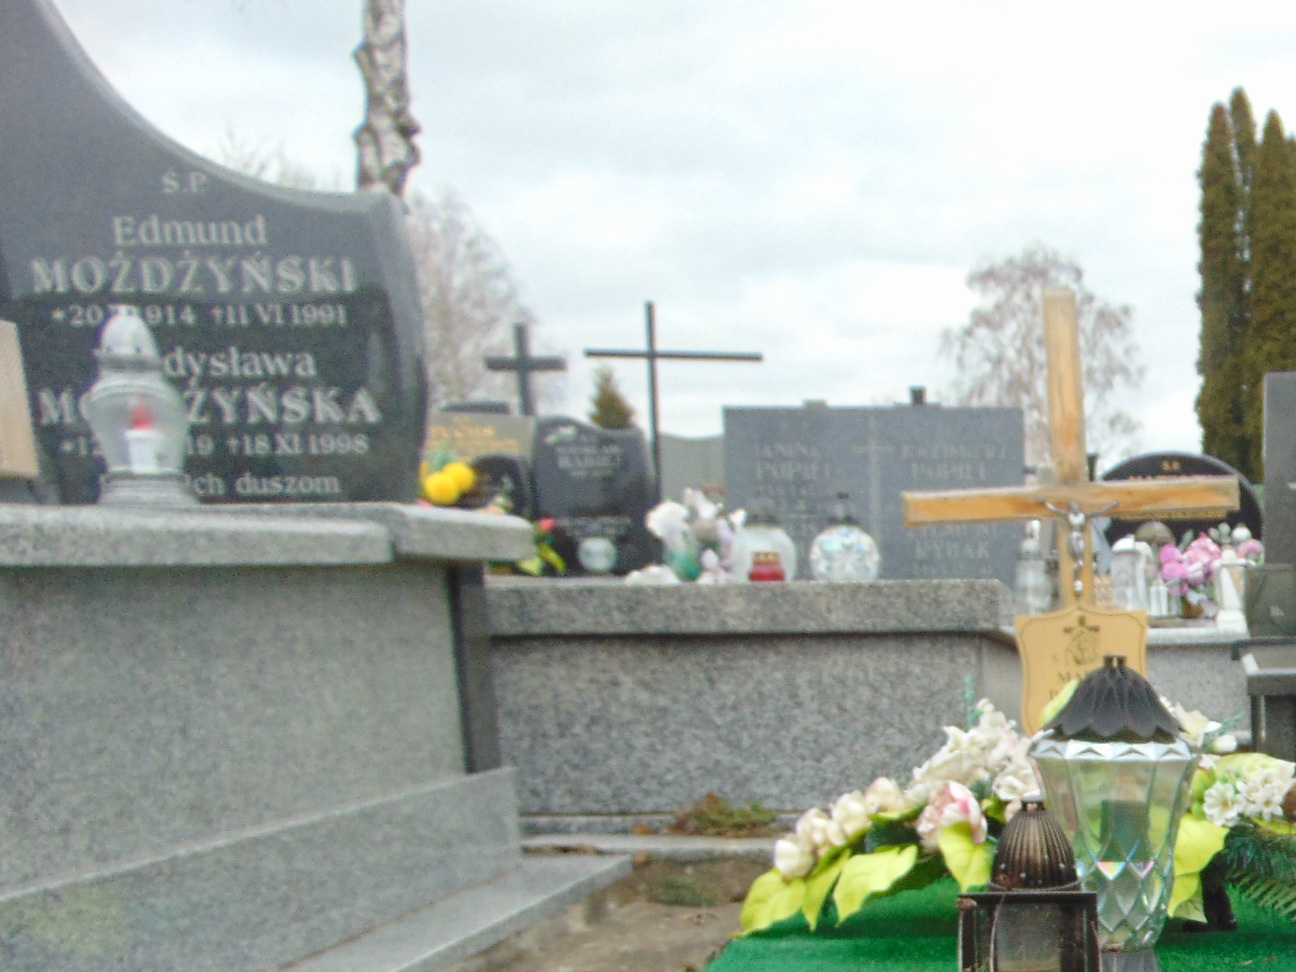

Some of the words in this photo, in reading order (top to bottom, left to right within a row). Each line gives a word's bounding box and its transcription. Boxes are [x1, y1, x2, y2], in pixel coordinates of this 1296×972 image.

[112, 214, 268, 246] Edmund
[31, 251, 358, 295] MOŻDŻYŃSKI
[290, 303, 347, 326] 1991
[162, 345, 318, 382] dysława
[308, 431, 370, 454] 1998
[235, 471, 341, 494] duszom
